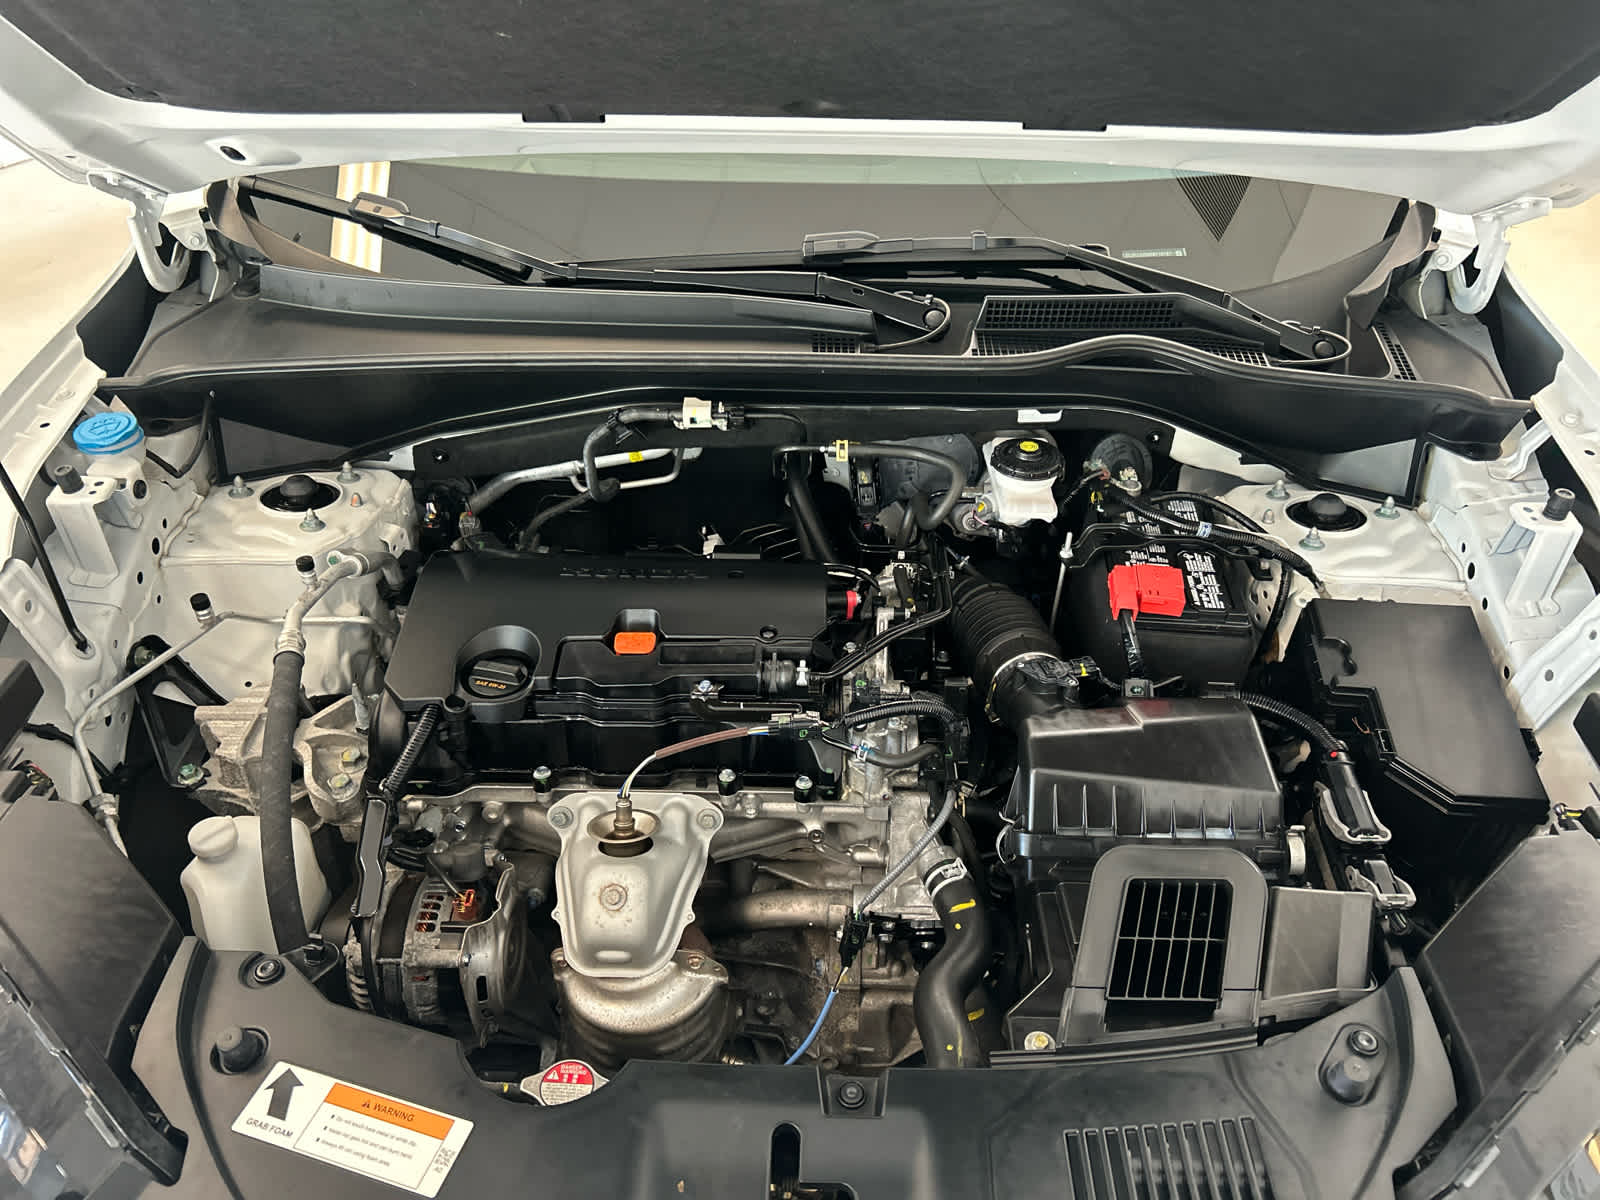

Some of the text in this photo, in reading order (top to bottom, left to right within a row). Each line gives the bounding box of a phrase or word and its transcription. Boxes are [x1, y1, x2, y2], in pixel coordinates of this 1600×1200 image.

[373, 1103, 415, 1122] WARNING
[246, 1117, 293, 1137] GRAB FOAM
